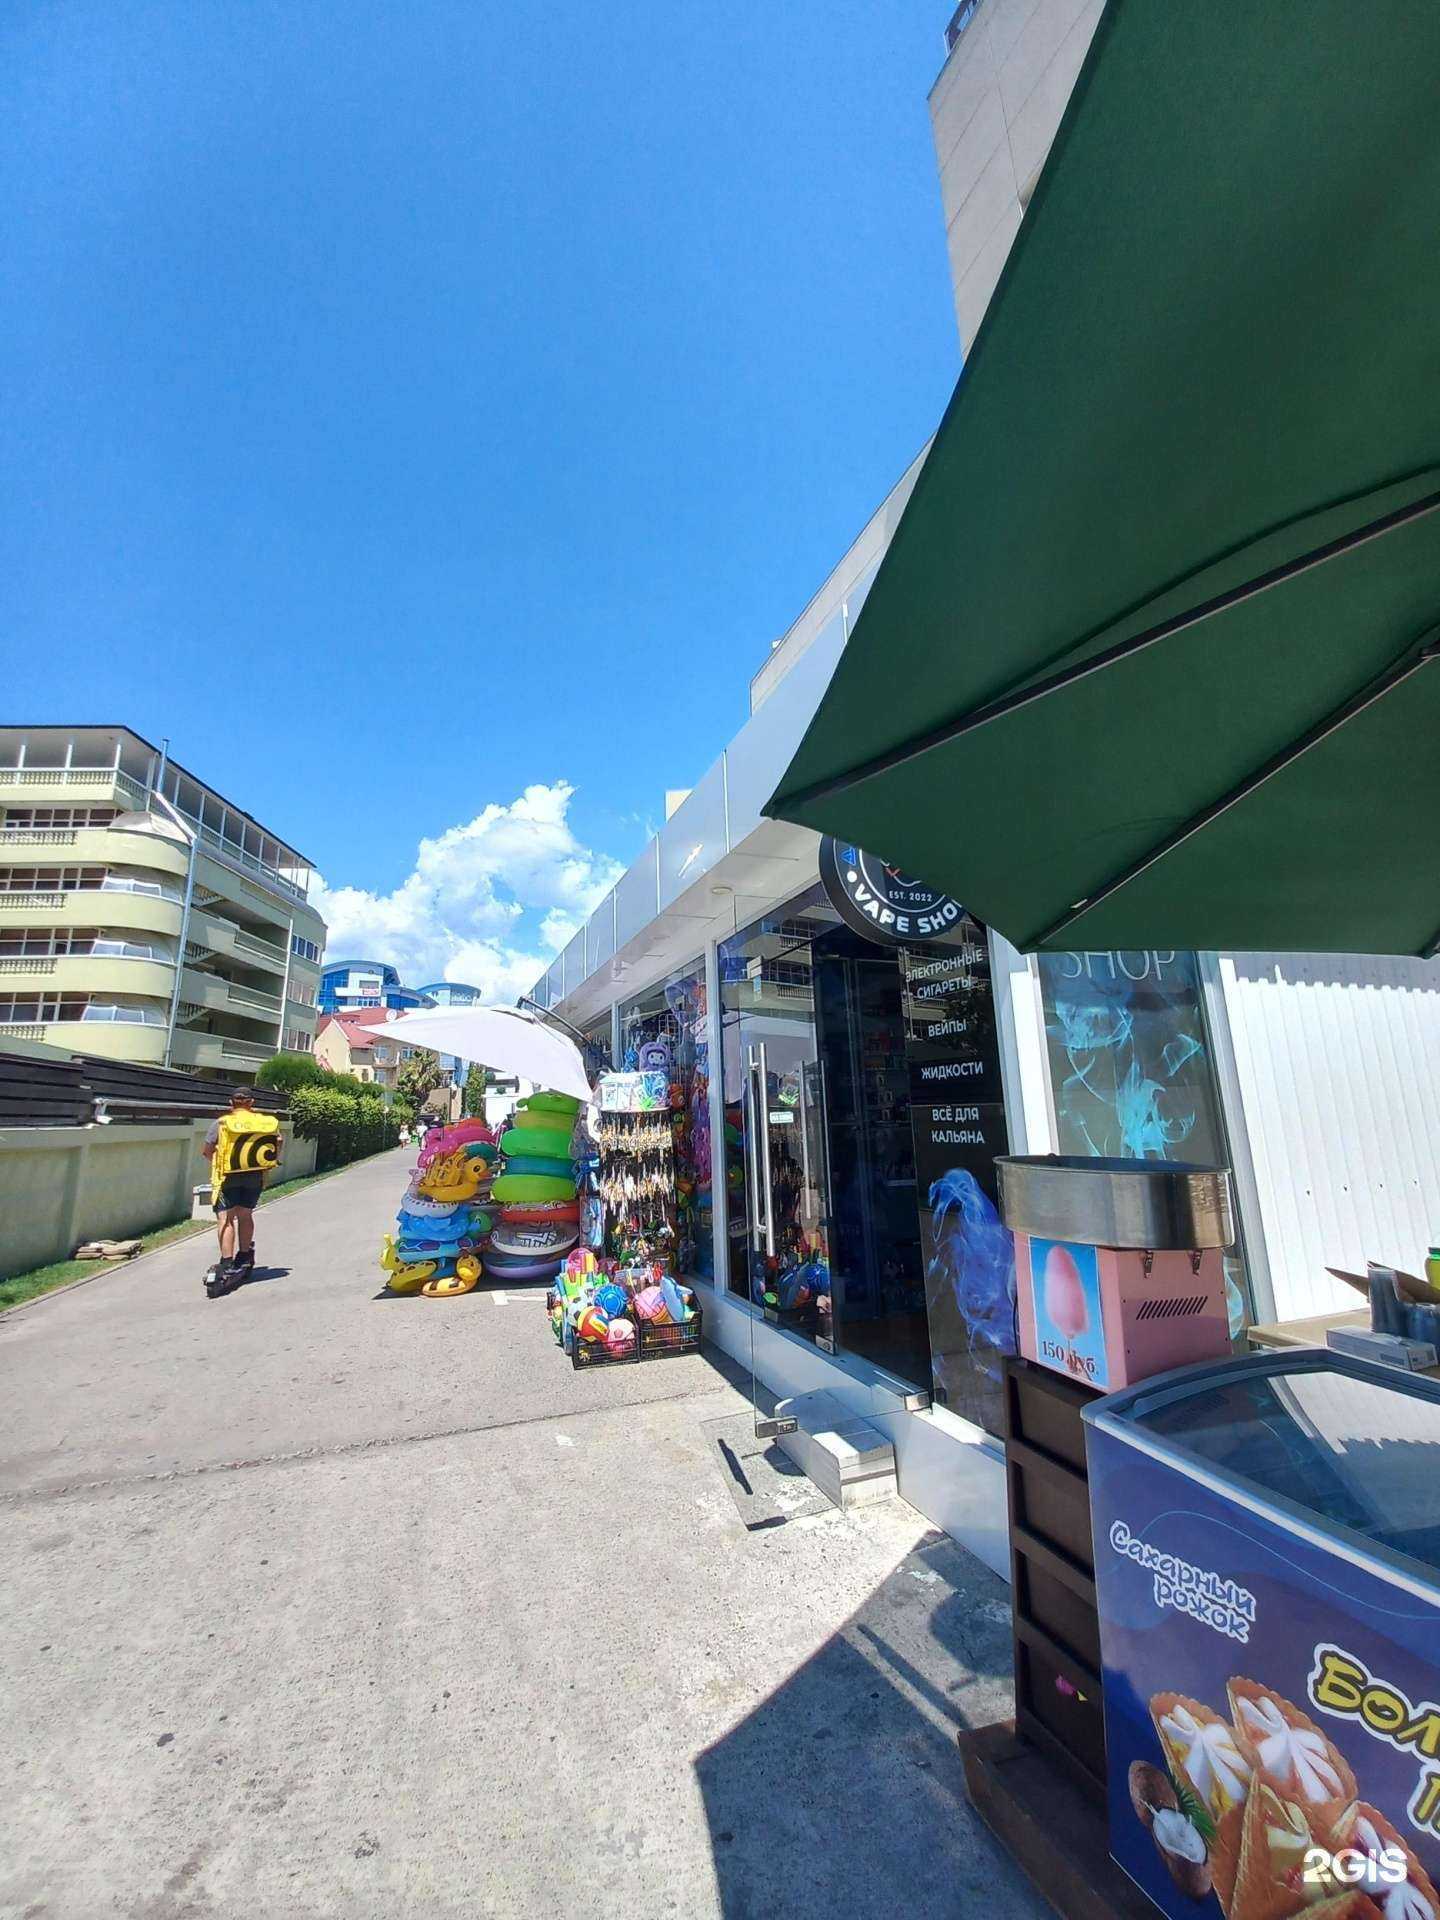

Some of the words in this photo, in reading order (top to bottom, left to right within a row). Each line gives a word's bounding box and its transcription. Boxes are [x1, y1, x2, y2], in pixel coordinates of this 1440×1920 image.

[889, 890, 906, 900] EST.
[909, 892, 932, 902] 2022
[854, 883, 910, 933] VAPE
[917, 899, 962, 934] SHO
[905, 949, 984, 983] ЭЛЕКТРОННЫЕ
[917, 975, 973, 1000] СИГАРЕТЫ
[928, 1018, 967, 1038] ВЕЙПЫ
[921, 1061, 984, 1081] ЖИДКОСТИ
[932, 1106, 953, 1122] ВСЁ
[955, 1107, 979, 1123] ДЛЯ
[931, 1130, 985, 1145] КАЛЬЯНА
[1043, 1340, 1065, 1361] 150
[1111, 1521, 1256, 1621] Сахарный
[1154, 1574, 1249, 1643] рожок
